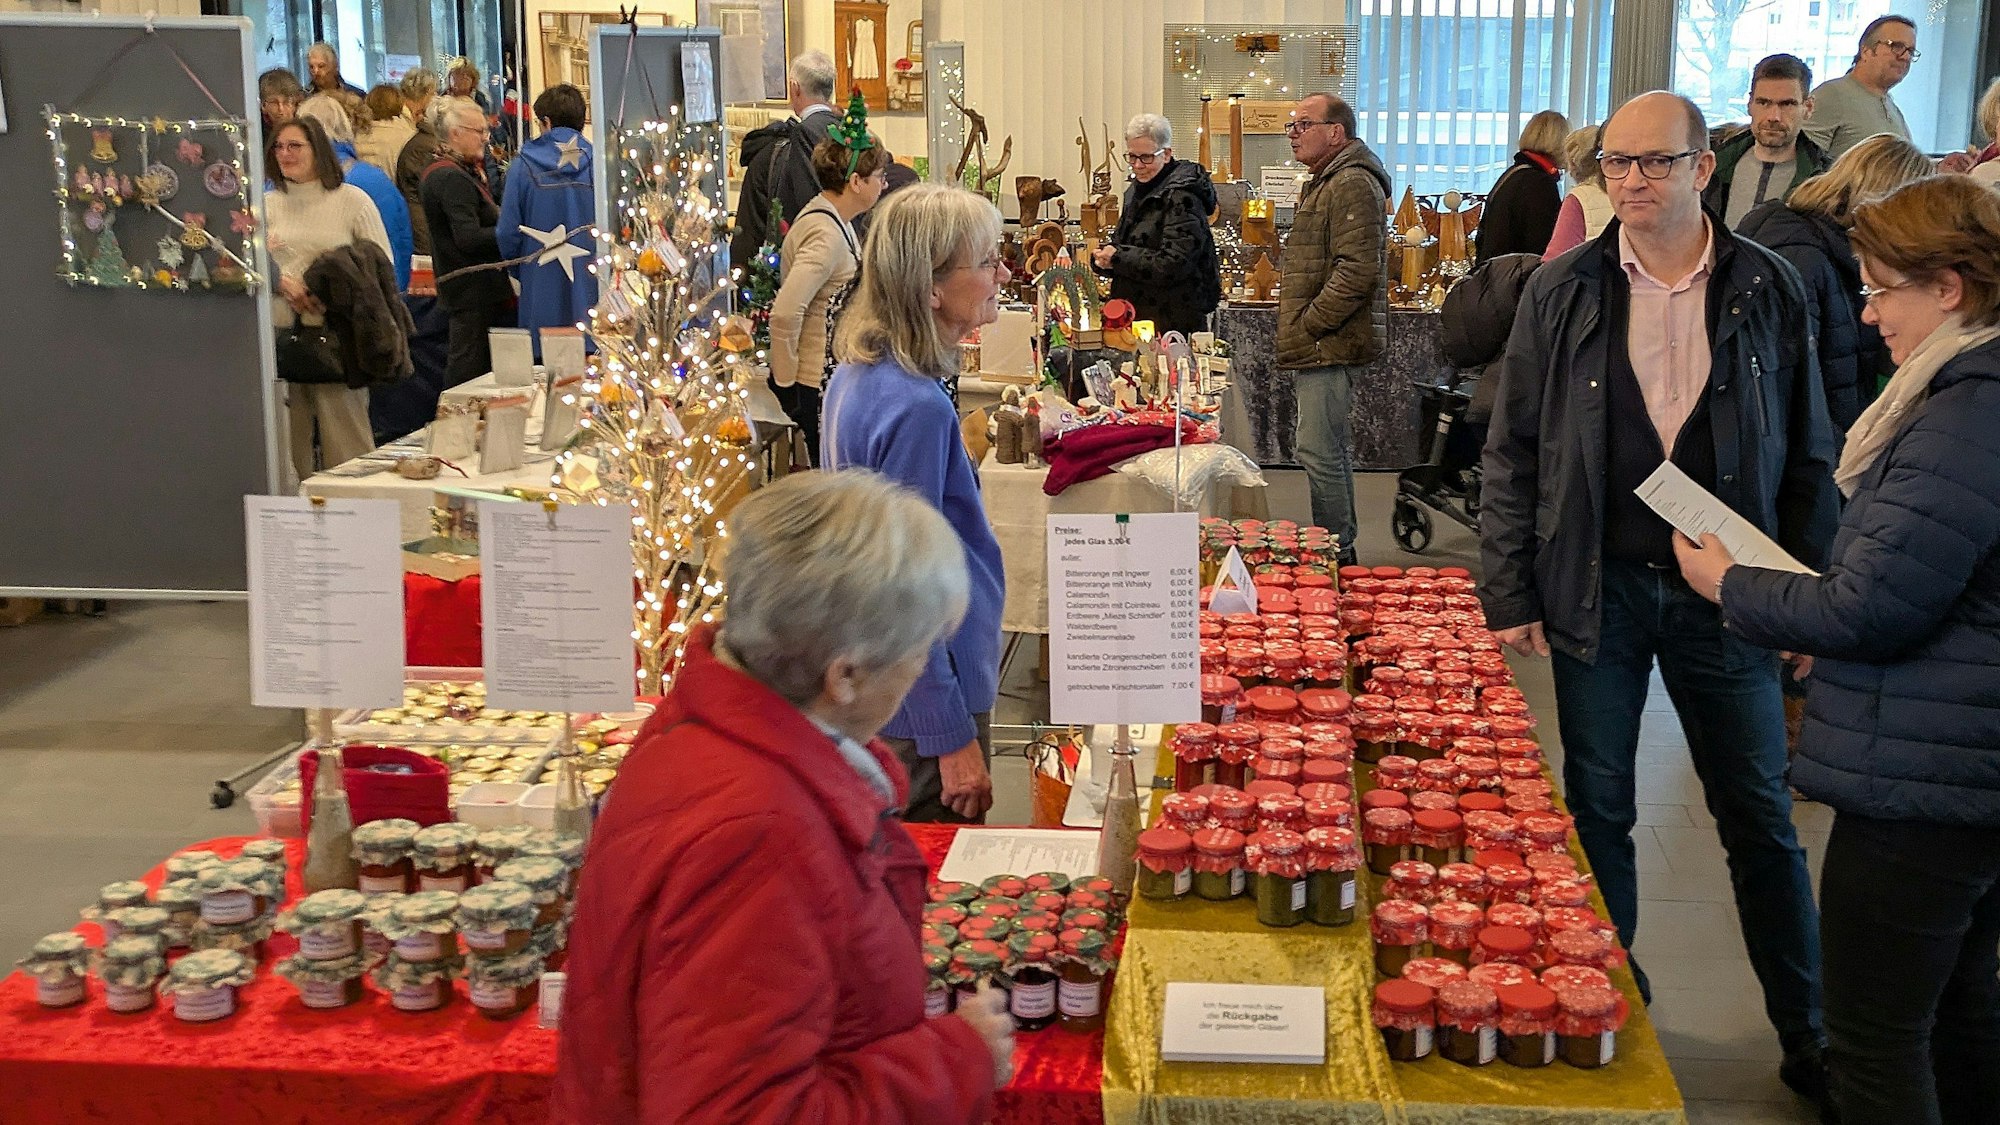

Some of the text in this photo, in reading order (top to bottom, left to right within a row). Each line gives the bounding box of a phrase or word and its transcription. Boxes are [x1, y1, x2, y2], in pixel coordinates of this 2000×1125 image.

[1054, 526, 1082, 535] Preise:
[1064, 537, 1086, 546] jedes
[1088, 537, 1106, 545] Glas
[1065, 570, 1110, 578] Bitterorange
[1125, 570, 1151, 579] Ingwer
[1066, 580, 1111, 589] Bitterorange
[1112, 580, 1124, 588] mit
[1125, 580, 1152, 589] Whisky
[1066, 590, 1110, 598] Calamondin
[1066, 601, 1111, 609] Calamondin
[1112, 601, 1123, 609] mit
[1124, 601, 1160, 609] Cointreau
[1066, 612, 1100, 620] Erdbeere
[1067, 622, 1118, 630] Walderdbeere
[1067, 633, 1135, 641] Zwiebelmarmelade
[1067, 652, 1100, 660] kandierte
[1102, 652, 1167, 662] Orangenscheiben
[1067, 663, 1101, 671] kandierte
[1102, 663, 1166, 671] Zitronenscheiben
[1067, 683, 1110, 692] getrocknete
[1111, 683, 1164, 691] Kirschtomaten
[1222, 1010, 1279, 1022] Rückgabe
